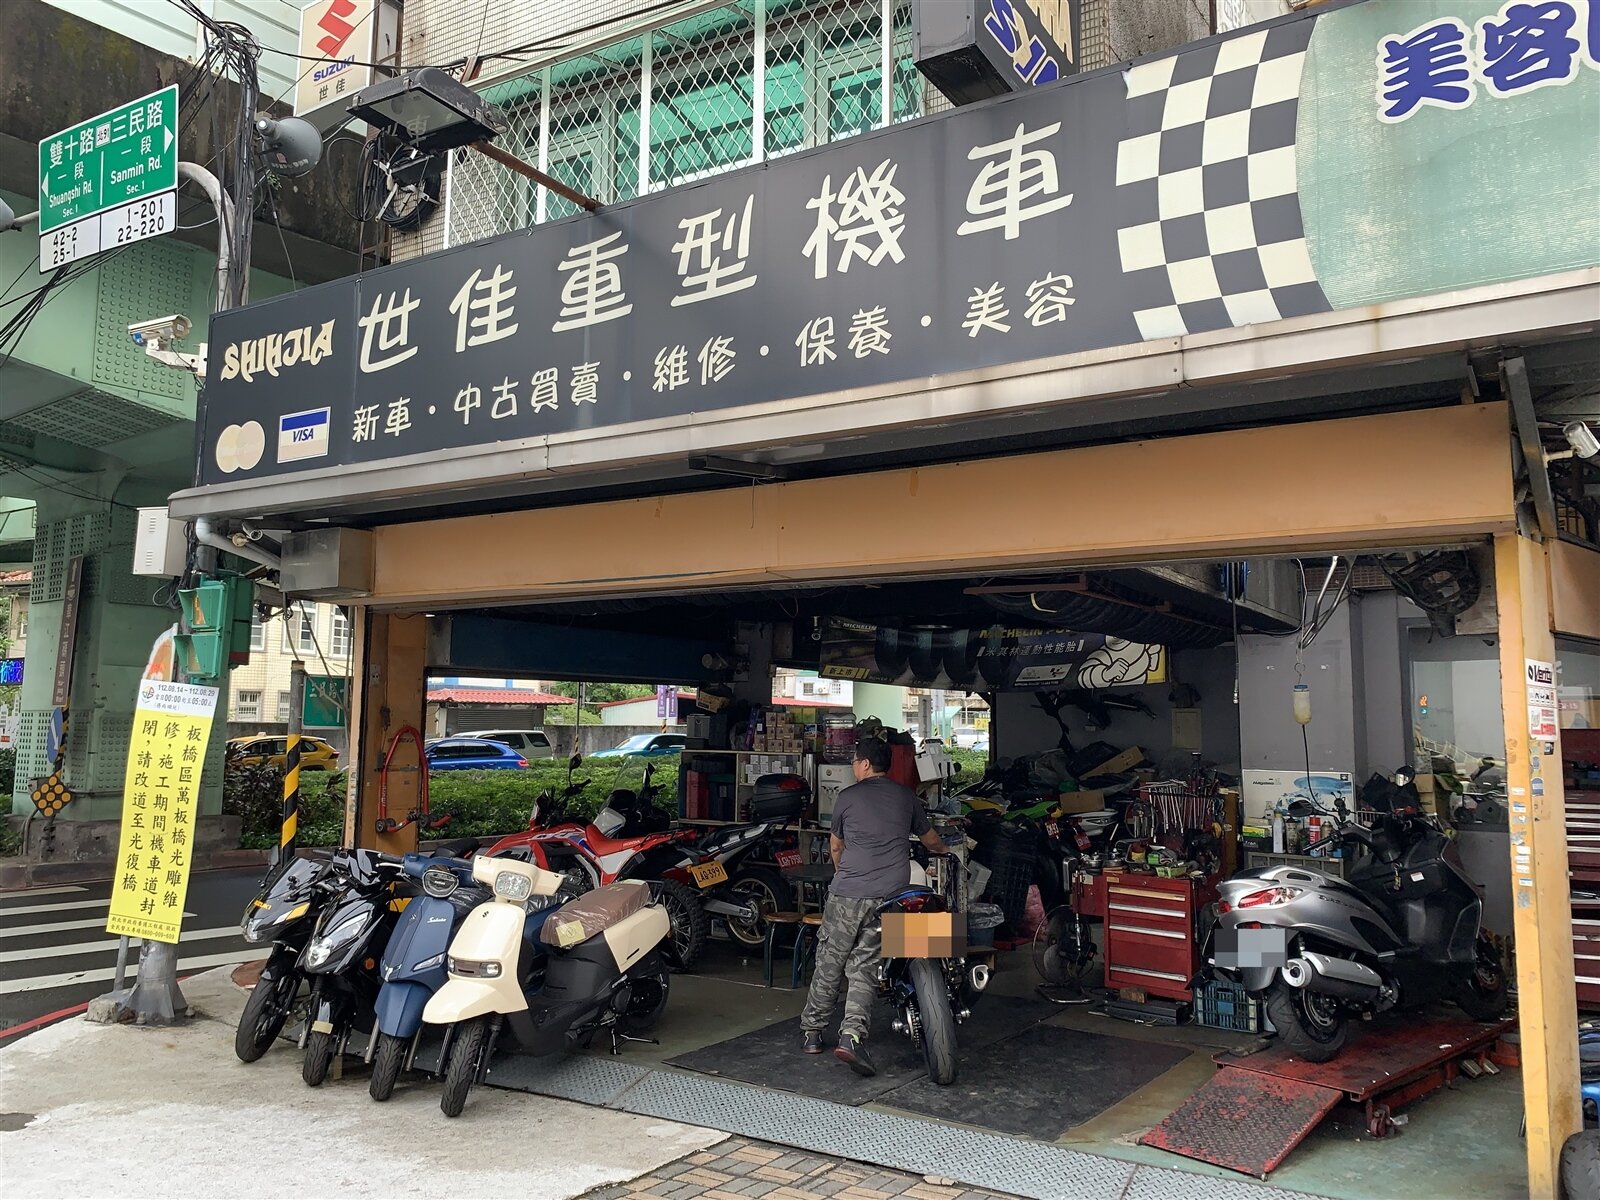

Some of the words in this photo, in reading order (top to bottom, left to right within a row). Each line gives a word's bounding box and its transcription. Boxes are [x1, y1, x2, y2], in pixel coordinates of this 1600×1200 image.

[313, 54, 355, 81] SUZUKI
[1376, 0, 1600, 124] 美容
[319, 77, 345, 100] 世佳
[112, 100, 163, 143] 三民路
[50, 128, 95, 168] 雙十路
[121, 135, 152, 155] 一段
[58, 161, 84, 180] 一段
[110, 162, 144, 185] Sanmin
[148, 155, 163, 170] Rd.
[49, 185, 81, 208] Shuangshi
[82, 181, 93, 195] Rd.
[126, 184, 140, 195] Sec.
[141, 180, 145, 190] 1
[62, 207, 74, 218] Sec.
[127, 198, 164, 223] 1-201
[53, 226, 78, 248] 42-2
[117, 216, 165, 243] 22-220
[53, 243, 76, 265] 25-1
[358, 121, 1074, 373] 世佳重型機車
[220, 319, 336, 383] SHIHJIA
[292, 427, 315, 443] VISA
[842, 622, 878, 631] MICHELIN
[163, 725, 202, 908] 板橋區萬板橋光雕維
